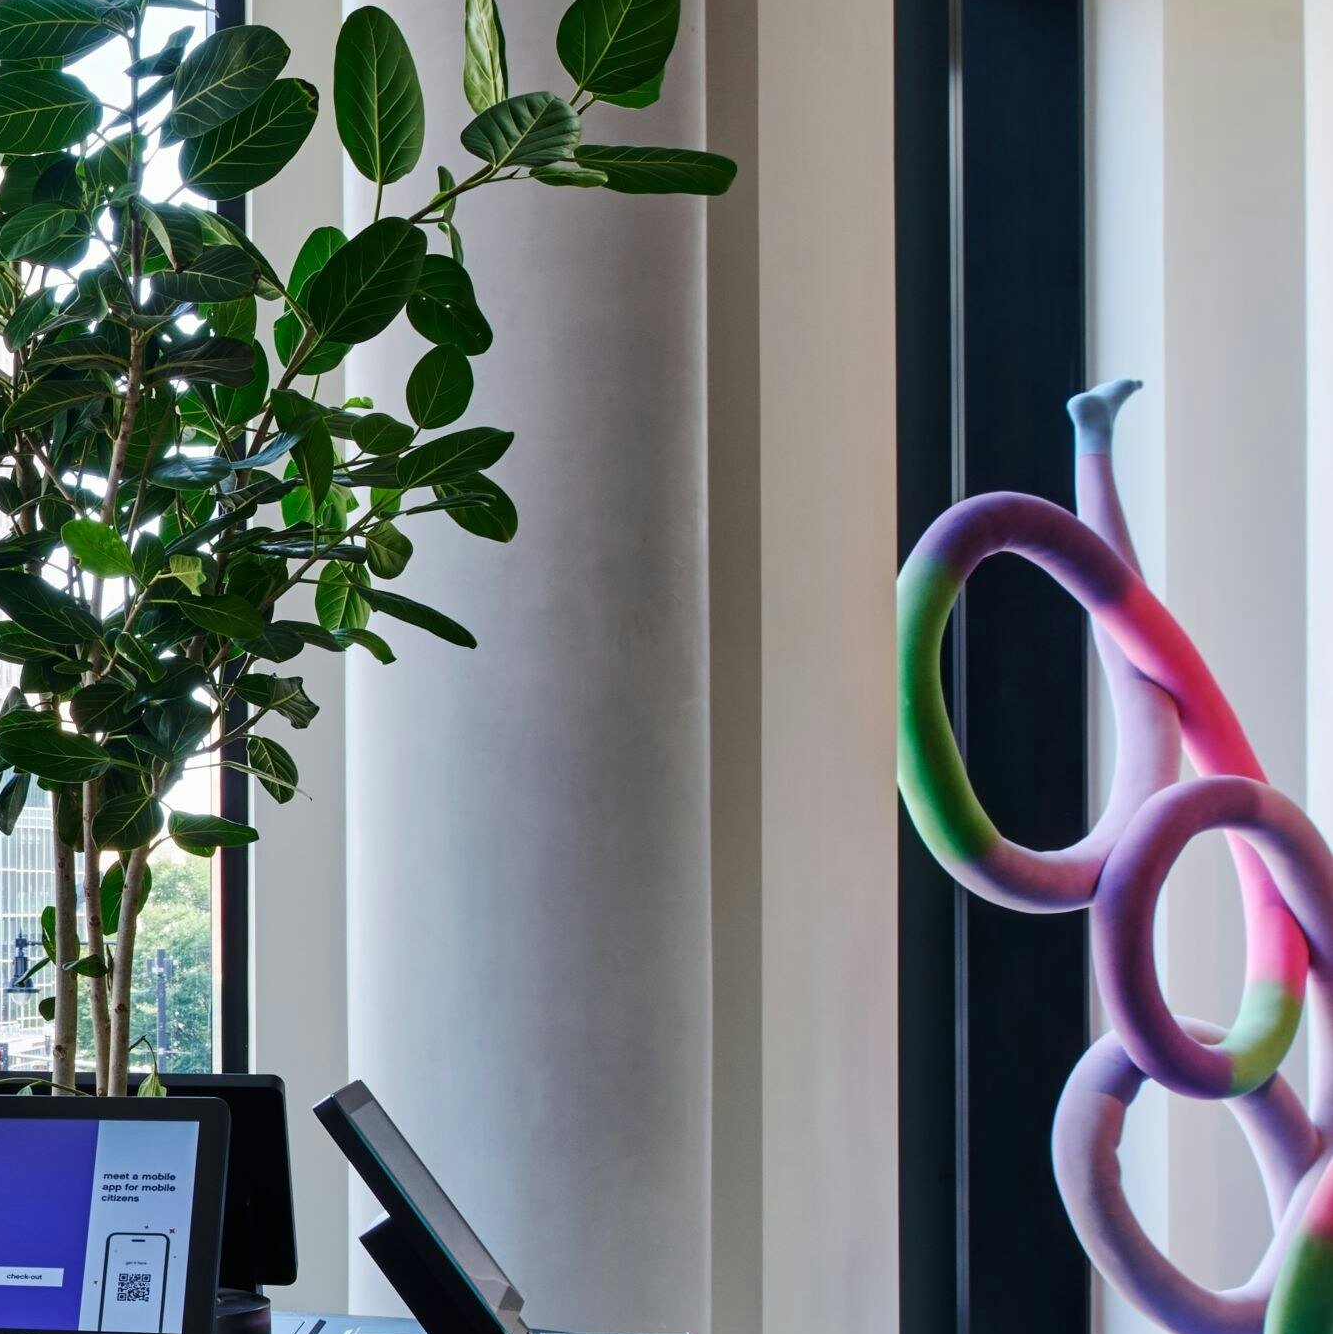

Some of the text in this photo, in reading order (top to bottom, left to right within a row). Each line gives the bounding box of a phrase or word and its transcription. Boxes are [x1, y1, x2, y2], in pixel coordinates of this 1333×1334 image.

[142, 1173, 176, 1181] mobile
[102, 1183, 176, 1192] app for mobile
[101, 1194, 140, 1202] citizens
